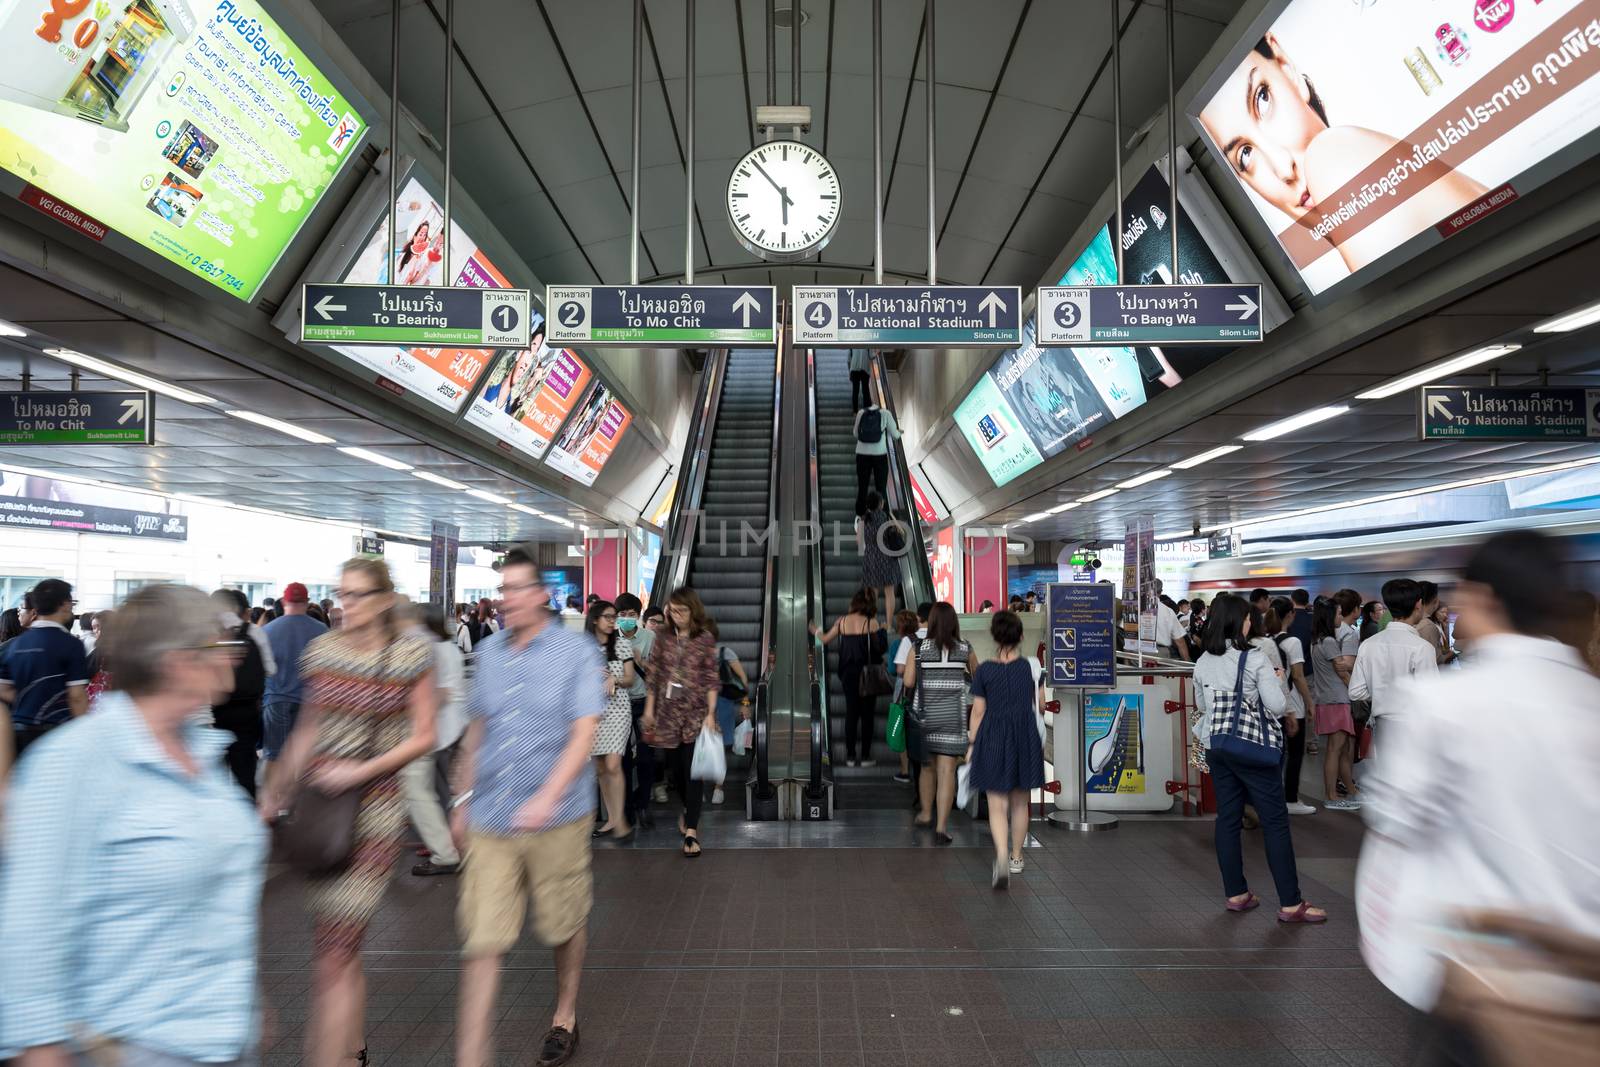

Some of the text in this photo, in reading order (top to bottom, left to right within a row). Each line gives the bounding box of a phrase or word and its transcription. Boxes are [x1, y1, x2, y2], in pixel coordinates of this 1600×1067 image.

[216, 0, 339, 128] ศูนย์ข้อมูลนักท่องเที่ยว
[193, 35, 229, 72] Tourist
[228, 69, 275, 119] Information
[274, 113, 301, 139] Center
[38, 196, 105, 239] VGI GLOBAL MEDIA
[1450, 188, 1515, 228] VGI GLOBAL MEDIA
[199, 257, 225, 279] 2617
[379, 291, 443, 313] ไปแบริ่ง
[618, 290, 705, 314] ไปหมอชิต
[847, 289, 967, 313] ไปสนามกีฬาฯ
[1116, 291, 1198, 311] ไปบางหว้า
[373, 313, 448, 327] To Bearing
[497, 307, 510, 329] 1
[563, 303, 580, 325] 2
[626, 316, 701, 327] To Mo Chit
[809, 303, 825, 325] 4
[842, 316, 983, 328] To National Stadium
[1060, 303, 1076, 326] 3
[1121, 314, 1197, 327] To Bang Wa
[423, 331, 462, 340] Sukhumvit
[487, 335, 520, 343] Platform
[802, 331, 833, 339] Platform
[973, 331, 995, 339] Silom
[1095, 329, 1130, 338] สายสีลม
[11, 396, 91, 417] ไปหมอชิต
[1462, 391, 1574, 412] ไปสนามกีฬาฯ
[16, 420, 85, 430] To Mo Chit
[1456, 415, 1585, 425] To National Stadium
